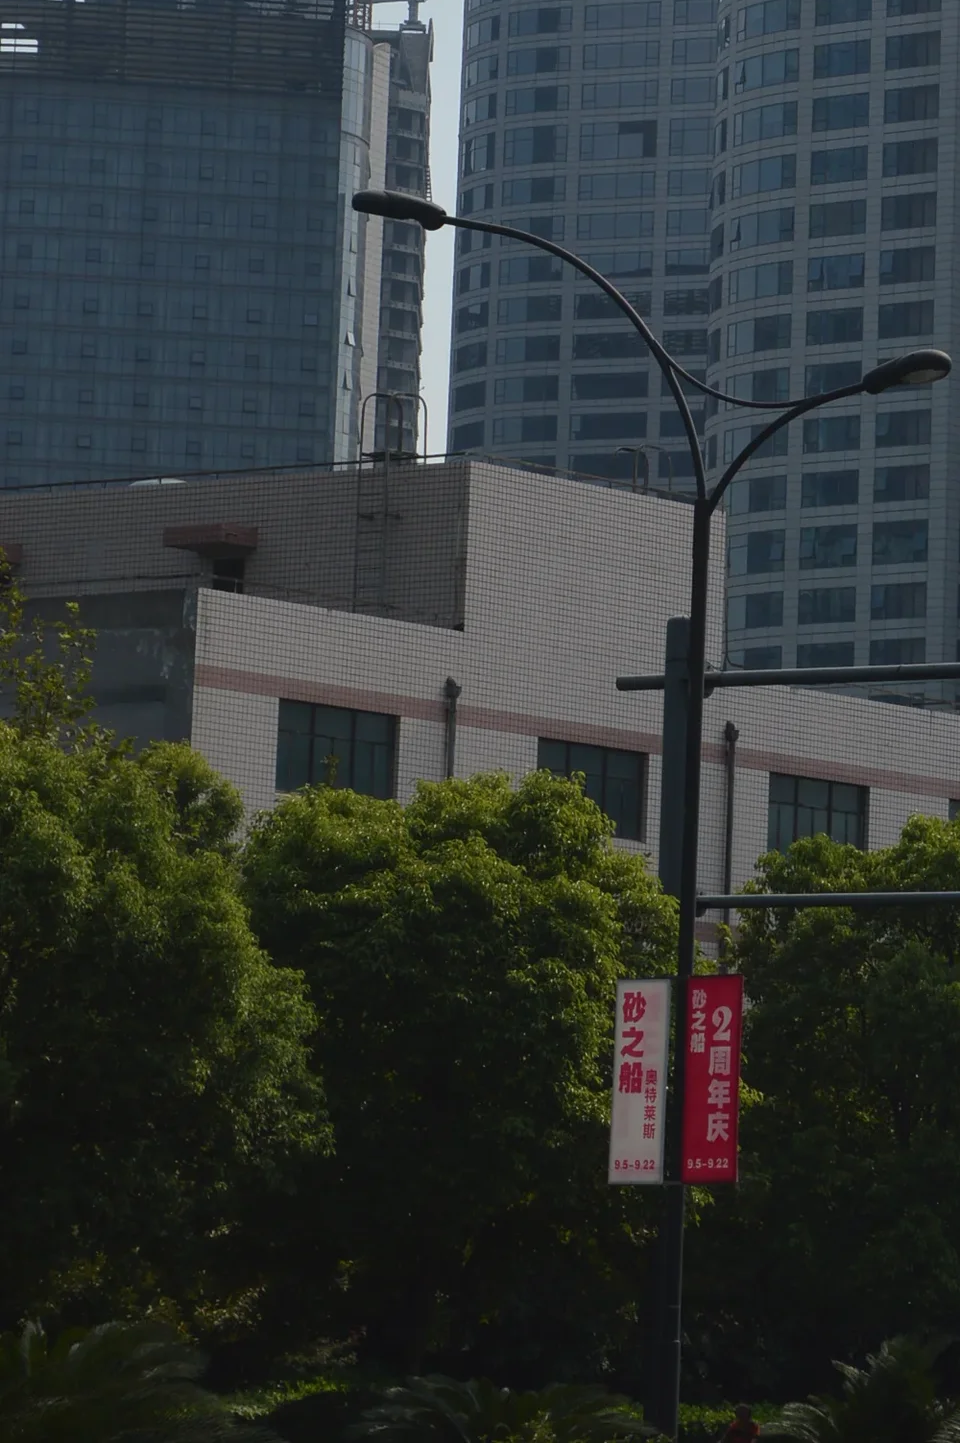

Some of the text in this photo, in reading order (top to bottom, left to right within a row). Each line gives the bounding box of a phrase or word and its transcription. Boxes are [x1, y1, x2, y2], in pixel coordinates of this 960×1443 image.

[618, 991, 647, 1094] 砂之船
[690, 989, 708, 1054] 砂之船
[642, 1068, 658, 1140] 奥特莱斯
[706, 1005, 733, 1143] 2周年庆
